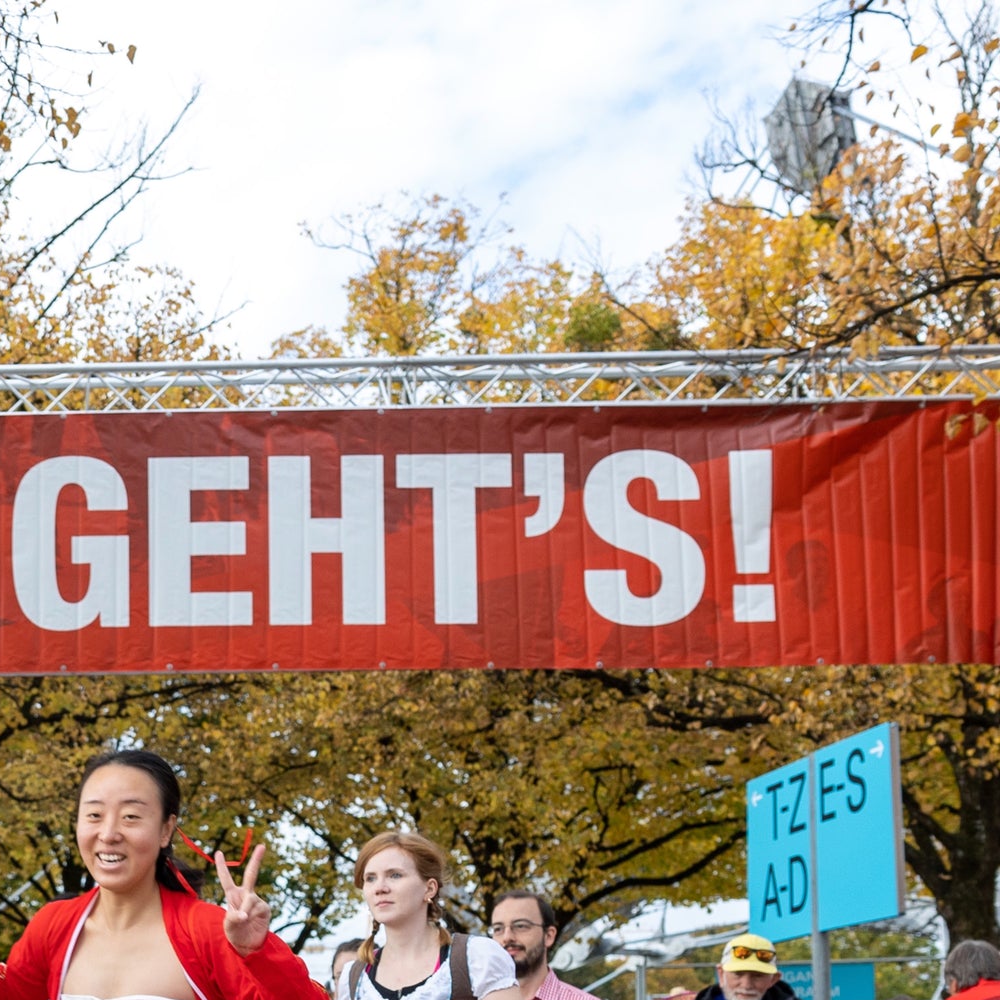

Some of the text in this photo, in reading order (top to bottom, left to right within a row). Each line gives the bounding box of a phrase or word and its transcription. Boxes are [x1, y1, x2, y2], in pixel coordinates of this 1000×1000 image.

[766, 771, 807, 840] T-Z
[820, 748, 867, 822] E-S
[761, 854, 808, 922] A-D
